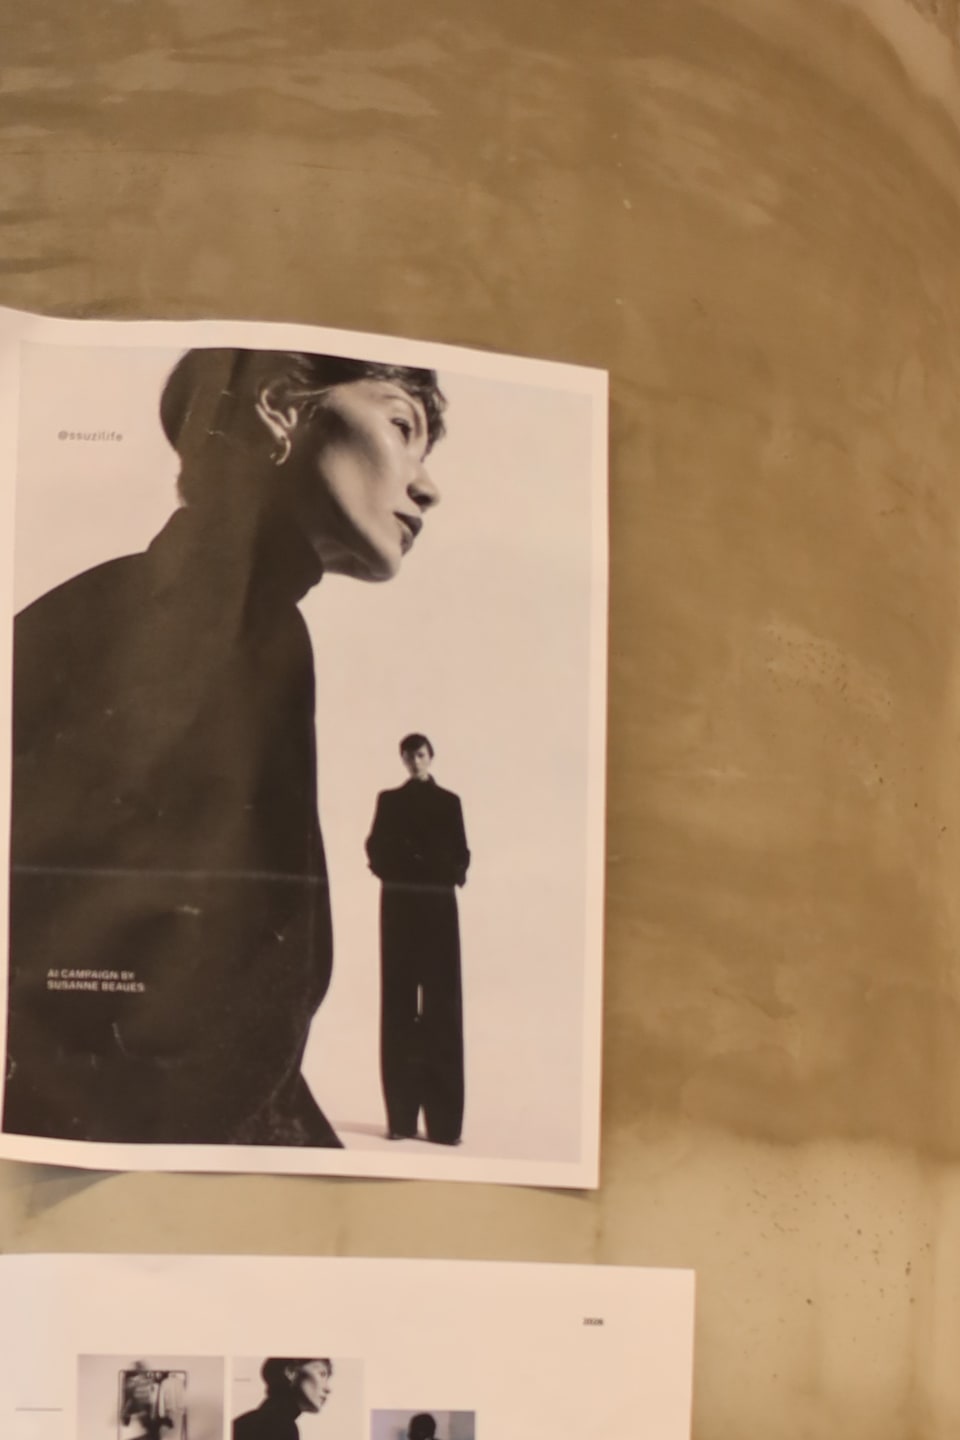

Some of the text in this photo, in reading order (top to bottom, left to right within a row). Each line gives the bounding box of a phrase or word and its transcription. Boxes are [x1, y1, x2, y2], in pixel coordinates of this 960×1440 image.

[61, 969, 119, 980] CAMPAIGN
[121, 971, 135, 980] BY
[47, 980, 99, 990] SUSANNE
